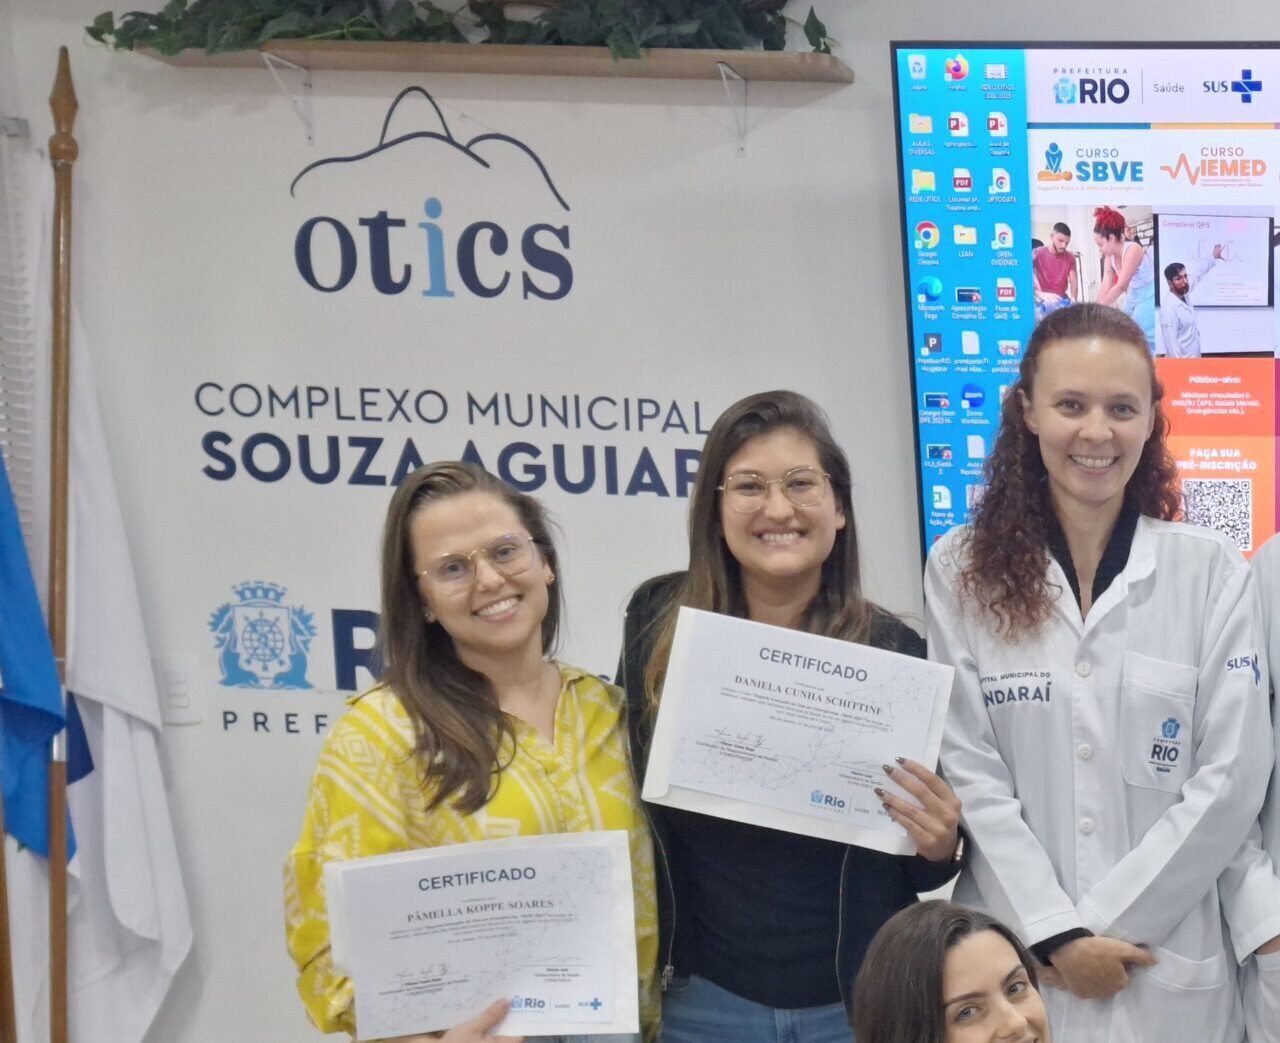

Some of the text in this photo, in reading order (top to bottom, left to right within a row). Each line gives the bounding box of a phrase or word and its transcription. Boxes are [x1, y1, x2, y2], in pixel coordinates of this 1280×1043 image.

[1080, 78, 1130, 104] RIO
[1153, 82, 1185, 94] Saúde
[1203, 80, 1229, 93] SUS
[1076, 149, 1119, 158] CURSO
[1201, 147, 1244, 157] CURSO
[1076, 161, 1143, 182] SBVE
[1201, 160, 1266, 177] IEMED
[294, 197, 574, 300] otics
[195, 382, 712, 435] COMPLEXO MUNICIPAL
[202, 431, 424, 486] SOUZA
[1190, 449, 1241, 460] FAÇA SUA
[758, 647, 868, 682] CERTIFICADO
[1226, 655, 1251, 672] SUS
[735, 675, 782, 693] DANIELA
[785, 686, 822, 703] CUNHA
[983, 681, 1052, 708] NDARAÍ
[1151, 744, 1179, 762] RIO
[825, 795, 846, 808] Rio
[418, 867, 536, 891] CERTIFICADO
[467, 902, 502, 914] KOPPE
[508, 899, 554, 909] SOARES
[524, 997, 545, 1008] Rio
